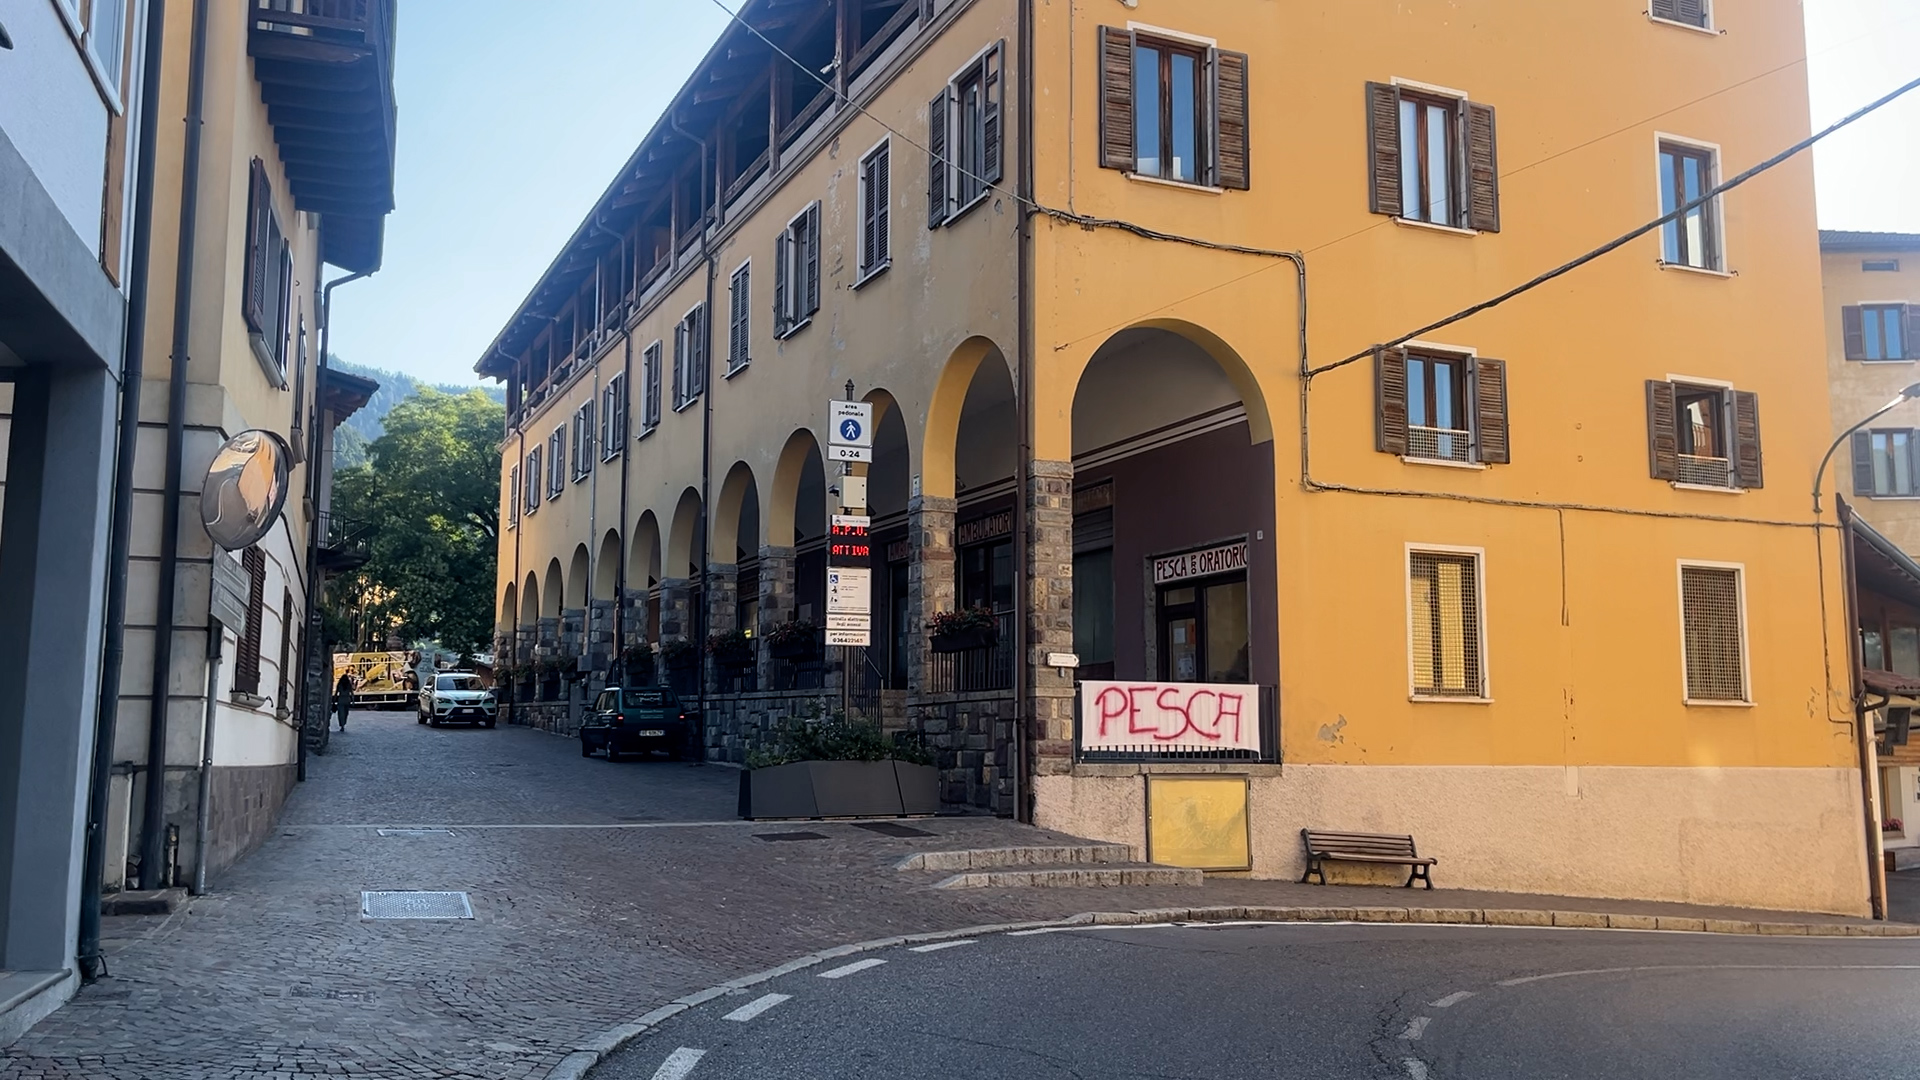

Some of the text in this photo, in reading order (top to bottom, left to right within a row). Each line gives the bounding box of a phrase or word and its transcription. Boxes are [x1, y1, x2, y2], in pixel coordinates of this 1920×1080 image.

[840, 450, 860, 458] 0-24
[832, 544, 869, 556] ATTIVA
[1156, 556, 1187, 580] PESCA
[1094, 686, 1243, 742] PESCA
